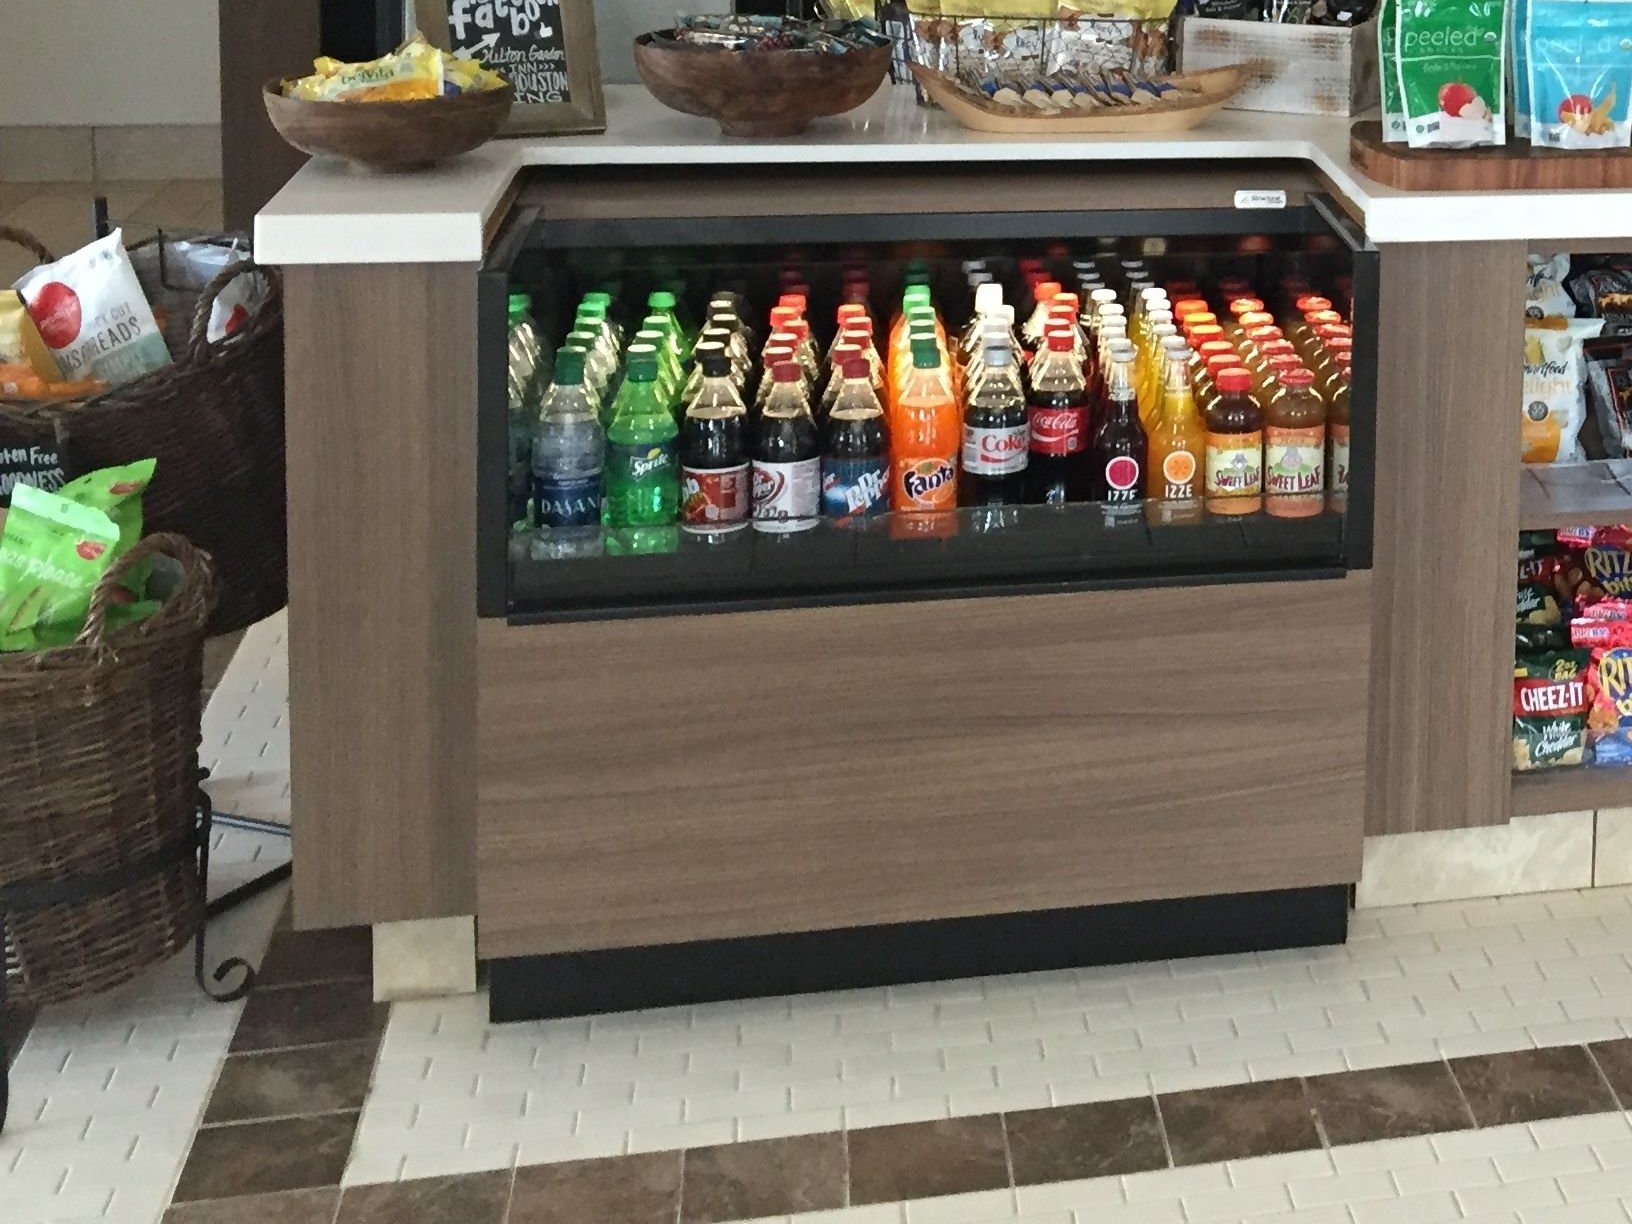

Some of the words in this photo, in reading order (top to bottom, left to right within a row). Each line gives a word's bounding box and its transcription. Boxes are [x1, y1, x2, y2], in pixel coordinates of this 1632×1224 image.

[1404, 25, 1478, 53] peeled
[30, 445, 58, 466] Free
[980, 433, 1026, 455] Coke
[633, 453, 670, 477] Sprite
[903, 465, 955, 499] Fanta
[1163, 484, 1195, 500] IZZE
[1520, 680, 1584, 714] CHEEZ-IT
